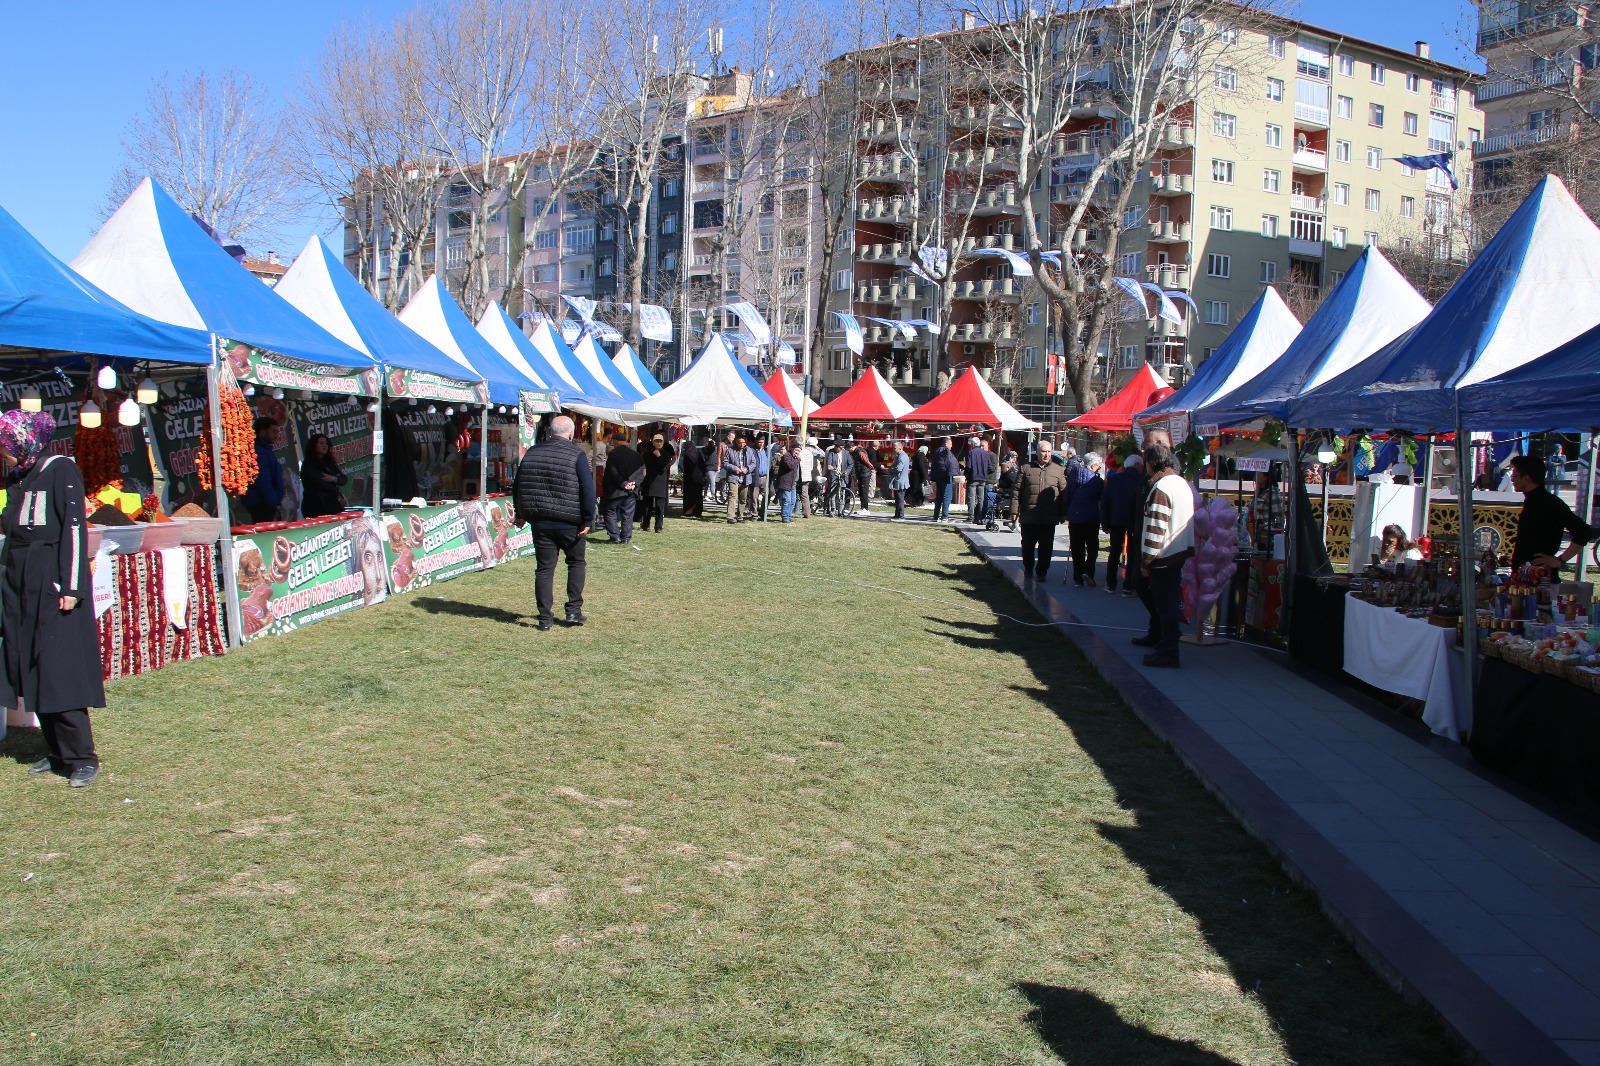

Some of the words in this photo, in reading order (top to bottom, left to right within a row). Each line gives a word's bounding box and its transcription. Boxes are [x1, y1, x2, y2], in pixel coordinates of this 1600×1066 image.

[165, 415, 204, 440] GELE
[423, 529, 446, 553] GELEN
[287, 556, 320, 589] GELEN
[320, 539, 352, 571] LEZZET
[272, 588, 312, 620] GAZİANTEP
